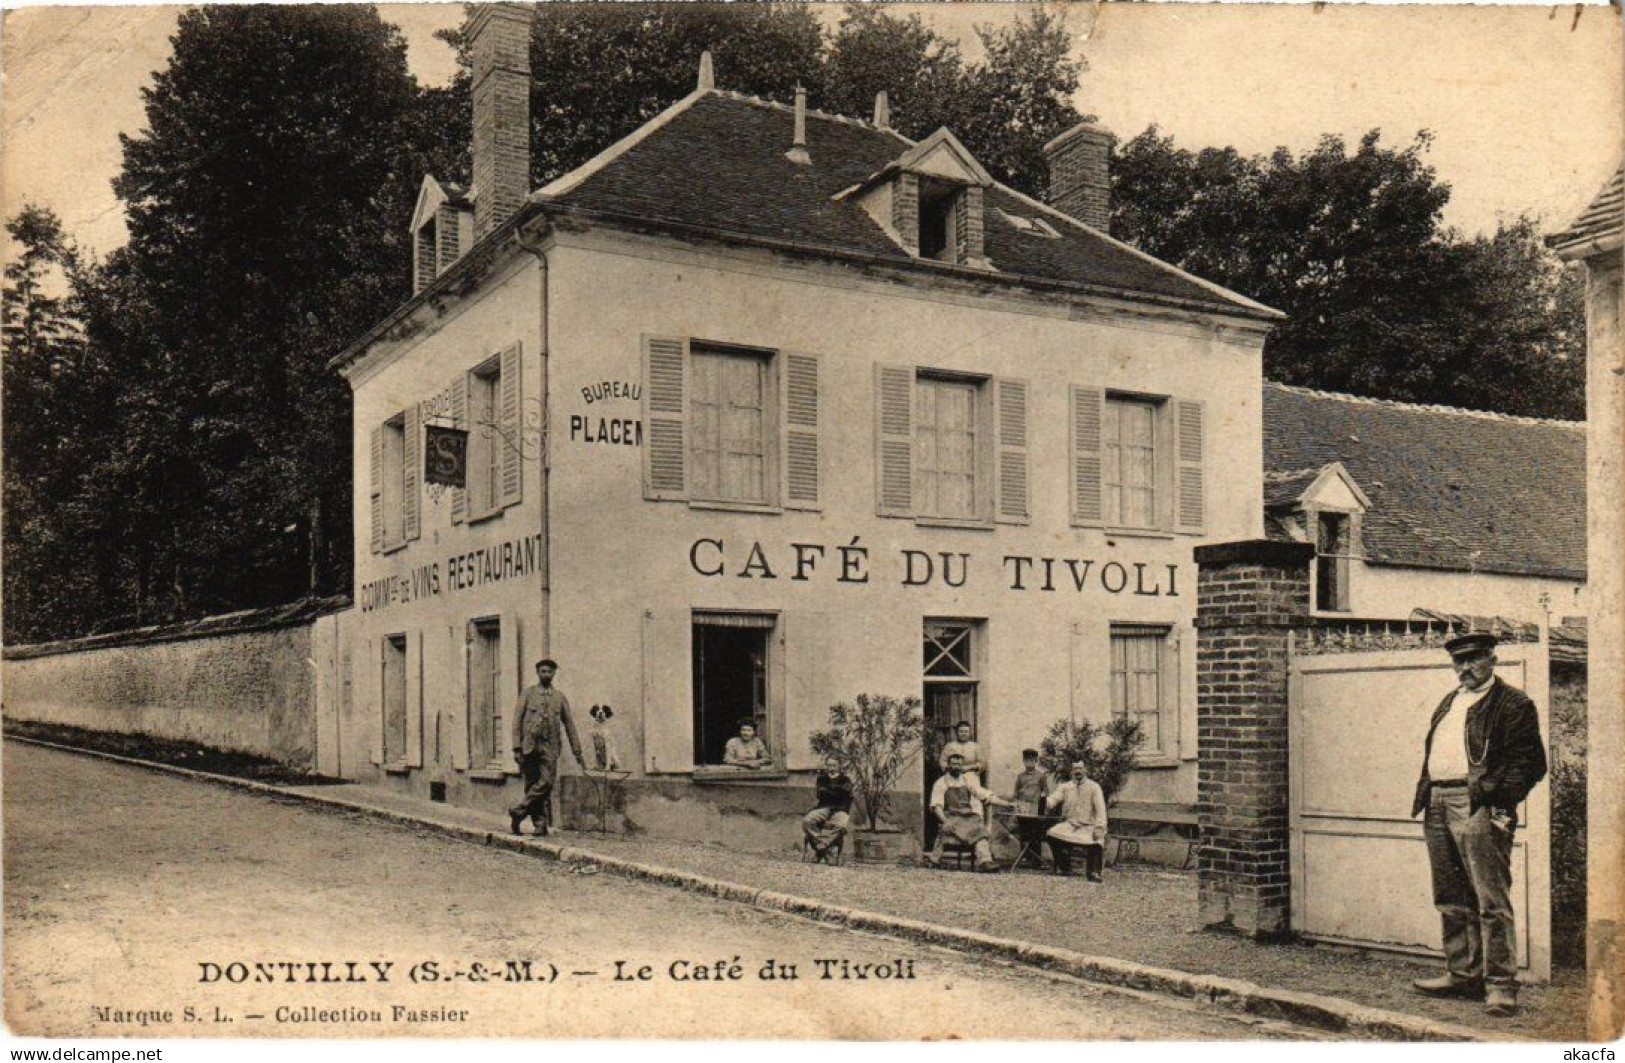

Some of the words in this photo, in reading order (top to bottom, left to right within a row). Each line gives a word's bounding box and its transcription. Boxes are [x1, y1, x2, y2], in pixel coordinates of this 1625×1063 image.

[581, 381, 642, 405] BUREAU
[448, 533, 542, 592] RESTAURANT
[689, 536, 869, 583] CAFÉ
[900, 550, 970, 588] DU
[1003, 555, 1179, 597] TIVOLI
